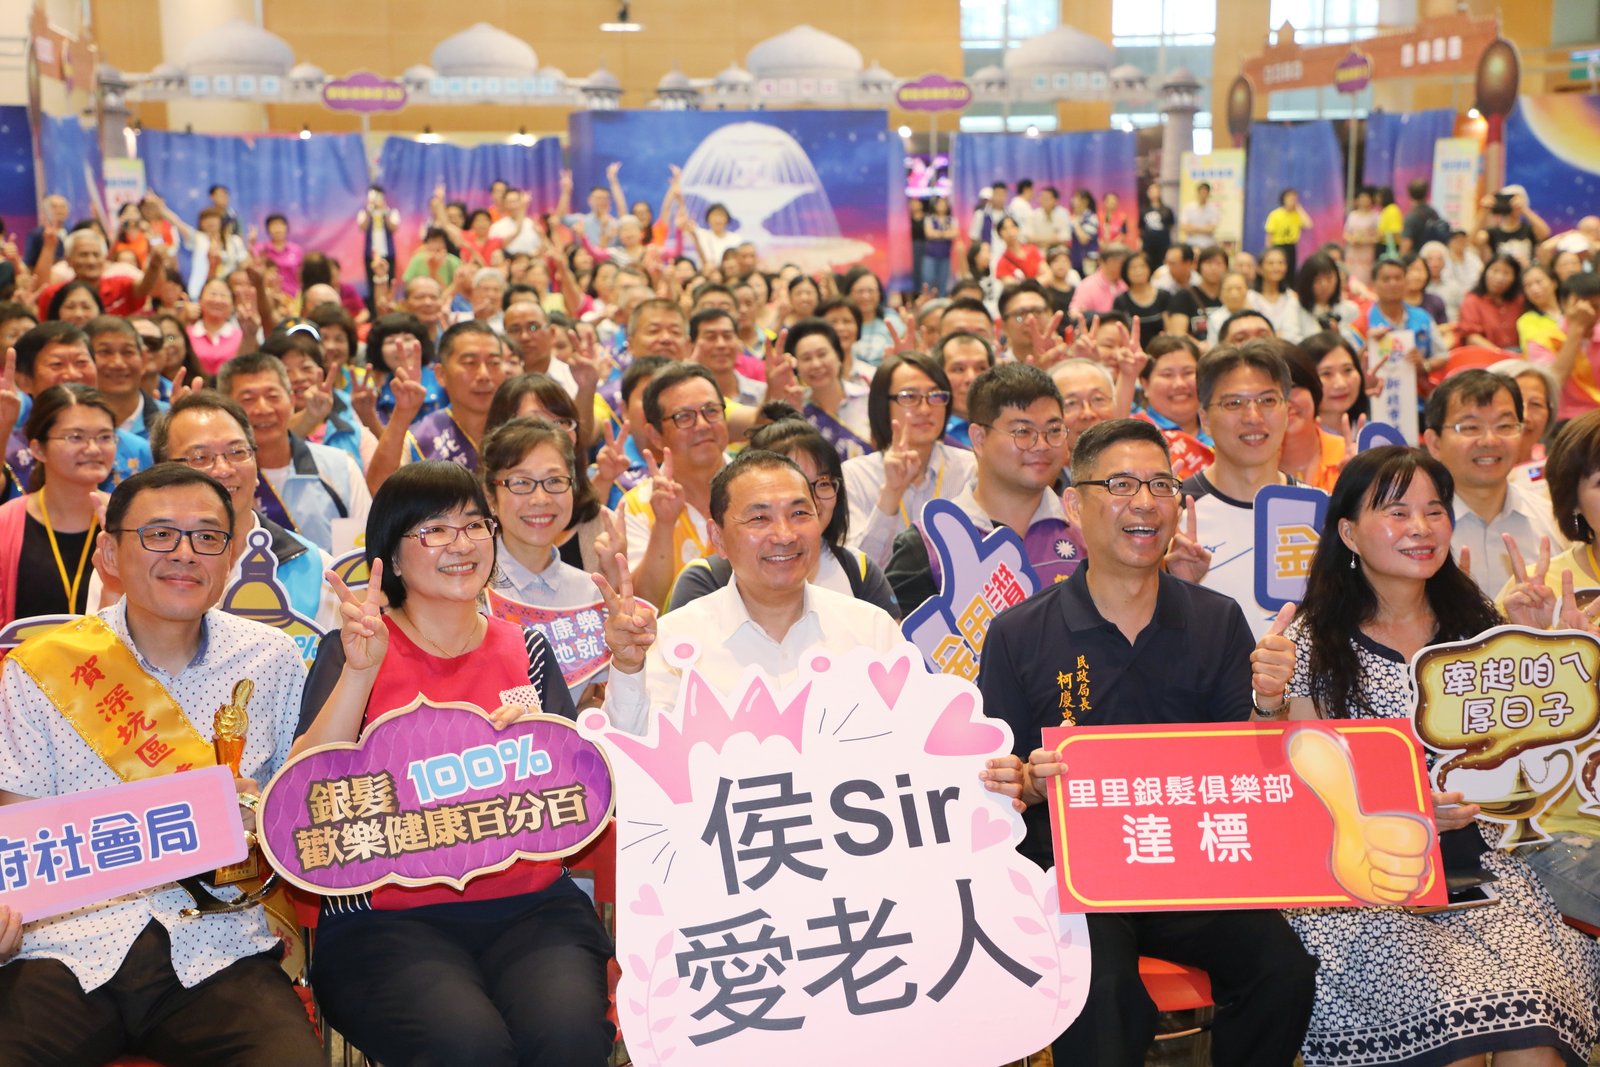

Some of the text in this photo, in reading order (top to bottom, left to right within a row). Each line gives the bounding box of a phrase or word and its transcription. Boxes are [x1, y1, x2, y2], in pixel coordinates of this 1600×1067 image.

[1076, 654, 1092, 711] 民政局長
[1462, 691, 1574, 735] 厚日子
[309, 734, 552, 825] 銀髮 100%
[1068, 773, 1294, 808] 里里銀髮俱樂部
[295, 785, 588, 871] 歡樂健康百分百
[675, 878, 1043, 1047] 愛老人
